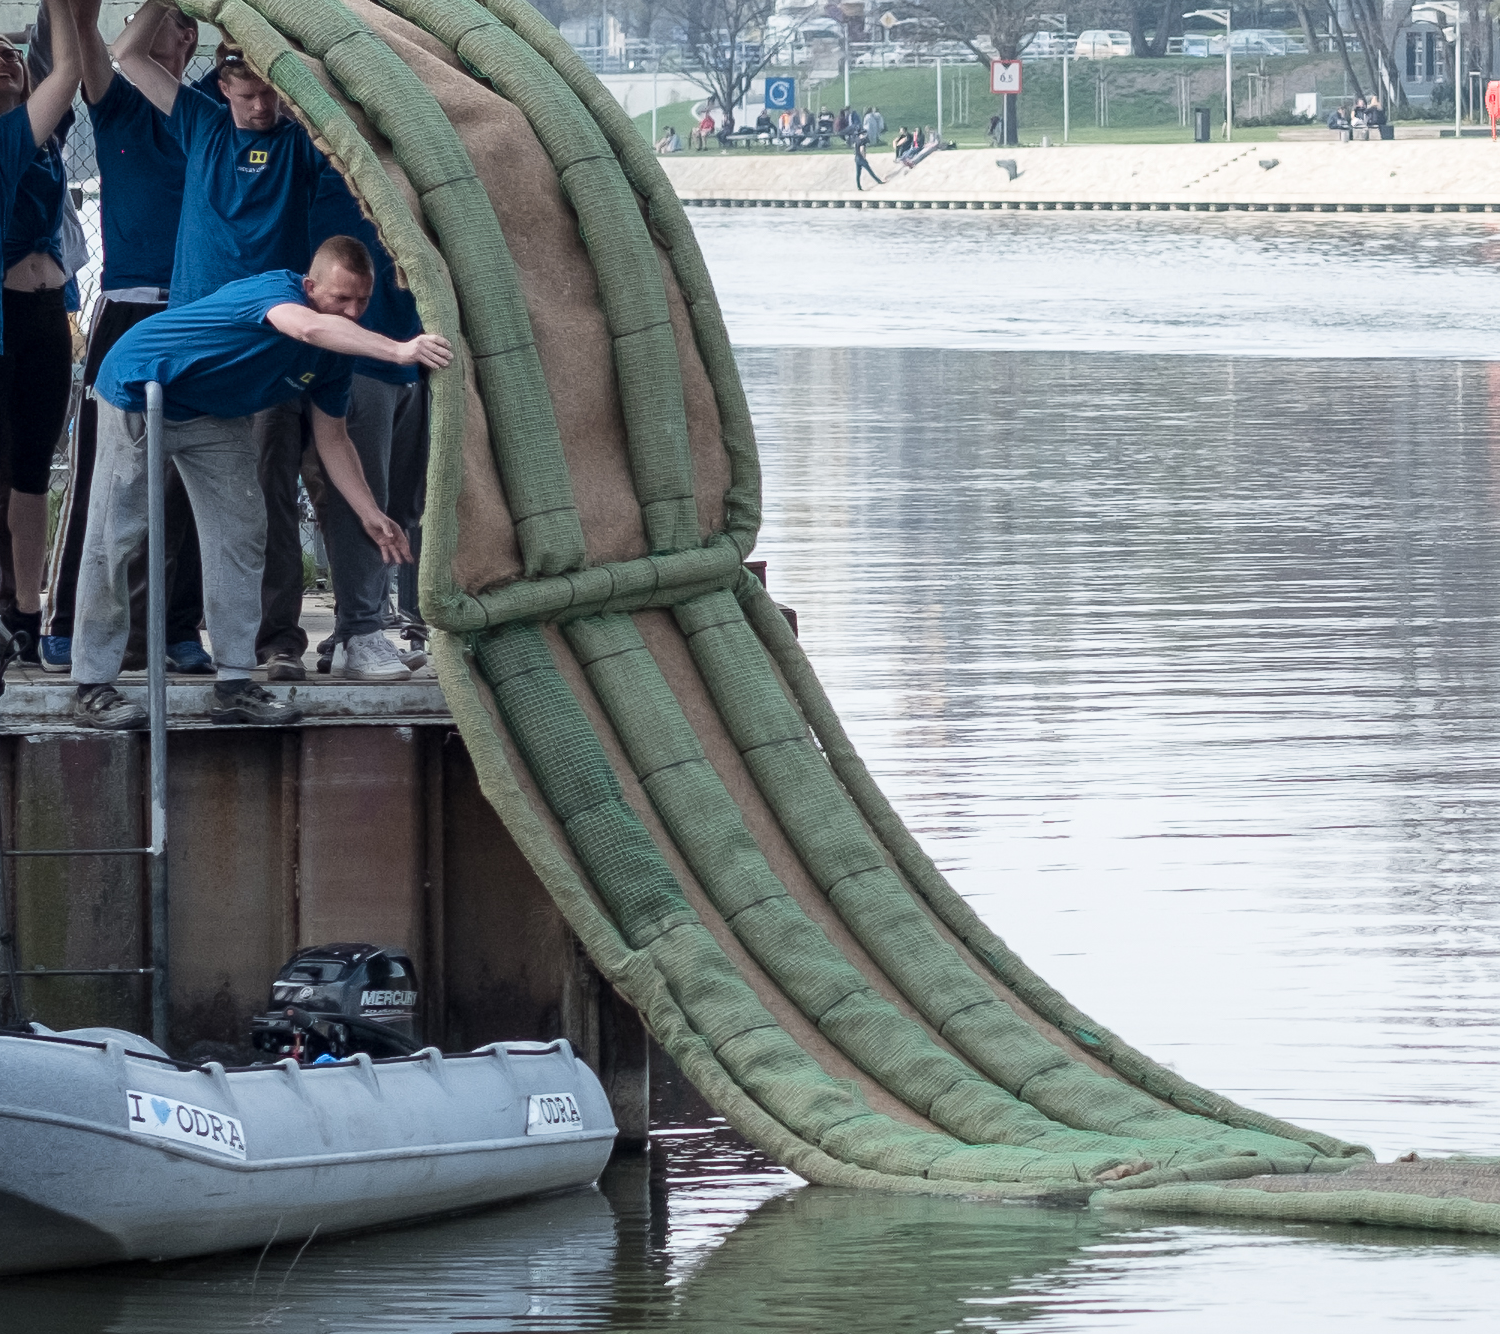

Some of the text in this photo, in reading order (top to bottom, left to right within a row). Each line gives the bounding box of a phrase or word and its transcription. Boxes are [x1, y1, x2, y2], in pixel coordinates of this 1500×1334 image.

[128, 1094, 245, 1151] I ODRA
[540, 1096, 581, 1124] ODRA
